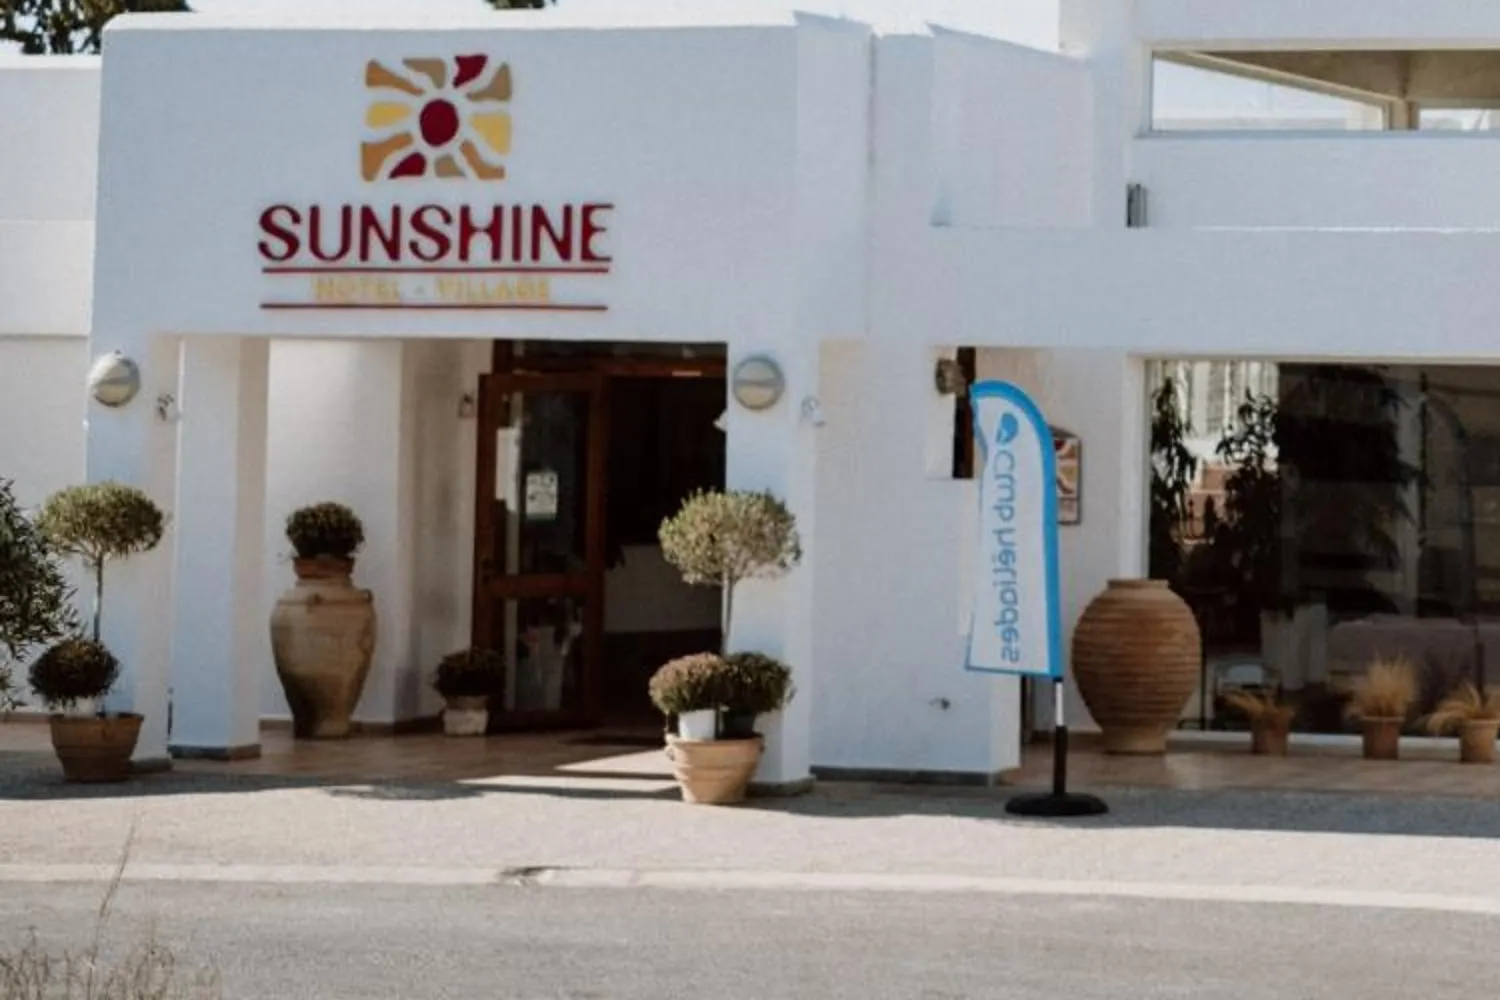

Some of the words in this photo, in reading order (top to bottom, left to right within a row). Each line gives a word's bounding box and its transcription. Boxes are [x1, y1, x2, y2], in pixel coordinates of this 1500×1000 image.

[258, 203, 614, 262] SUNSHINE
[316, 275, 402, 300] HOTEL
[434, 275, 550, 301] VILLAGE
